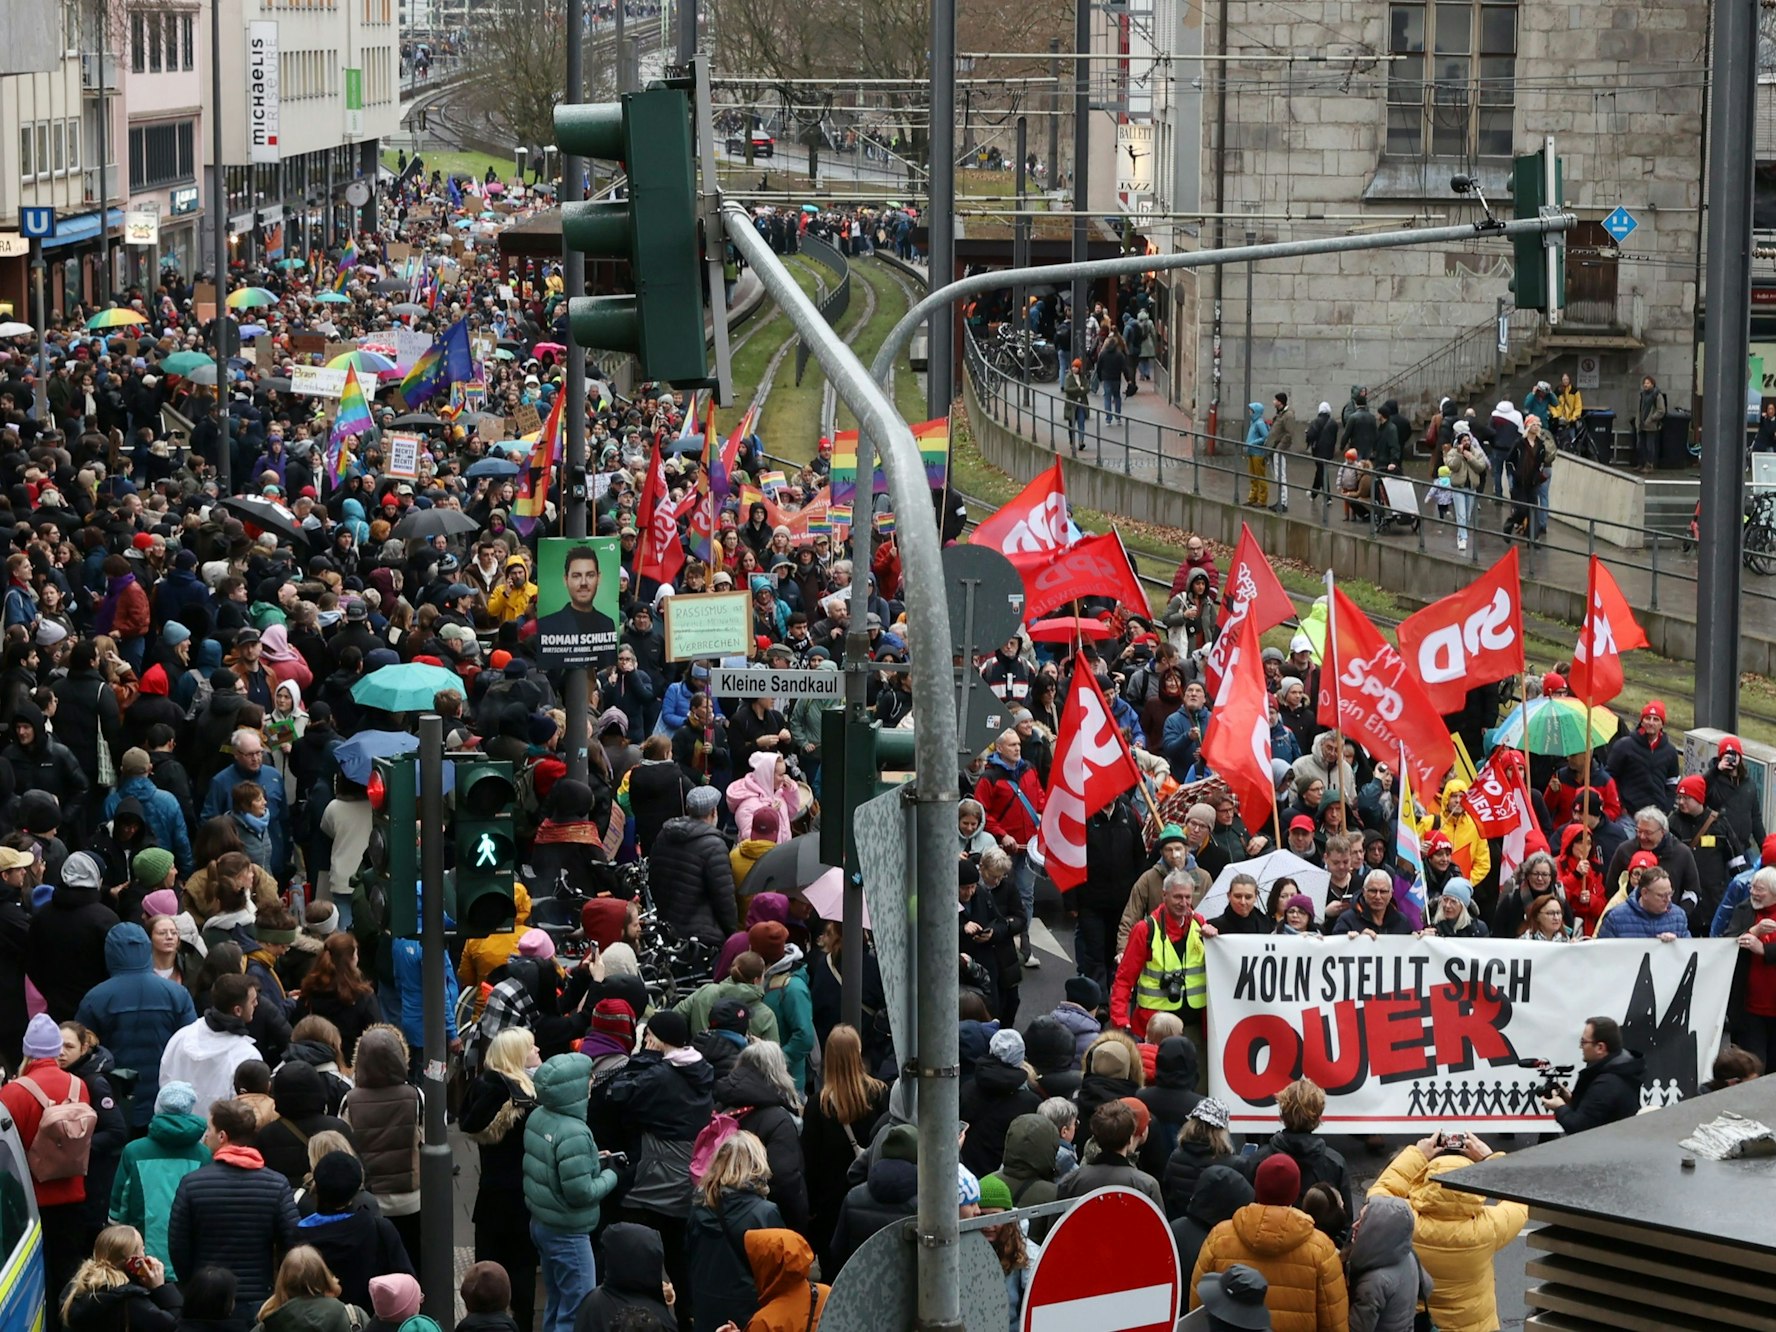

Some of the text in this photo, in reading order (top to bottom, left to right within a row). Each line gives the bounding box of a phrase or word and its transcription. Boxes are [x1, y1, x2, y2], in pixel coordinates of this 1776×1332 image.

[1119, 127, 1152, 140] BALLETT
[1118, 182, 1151, 192] JAZZ
[27, 211, 49, 233] U
[676, 605, 728, 619] RASSISMUS
[541, 631, 618, 646] ROMAN SCHULTE
[679, 638, 741, 653] VERBRECHEN
[722, 674, 838, 693] Kleine Sandkaul
[1340, 657, 1404, 722] SPD
[1233, 944, 1533, 1003] KÖLN STELLT SICH
[1223, 980, 1520, 1107] QUER
